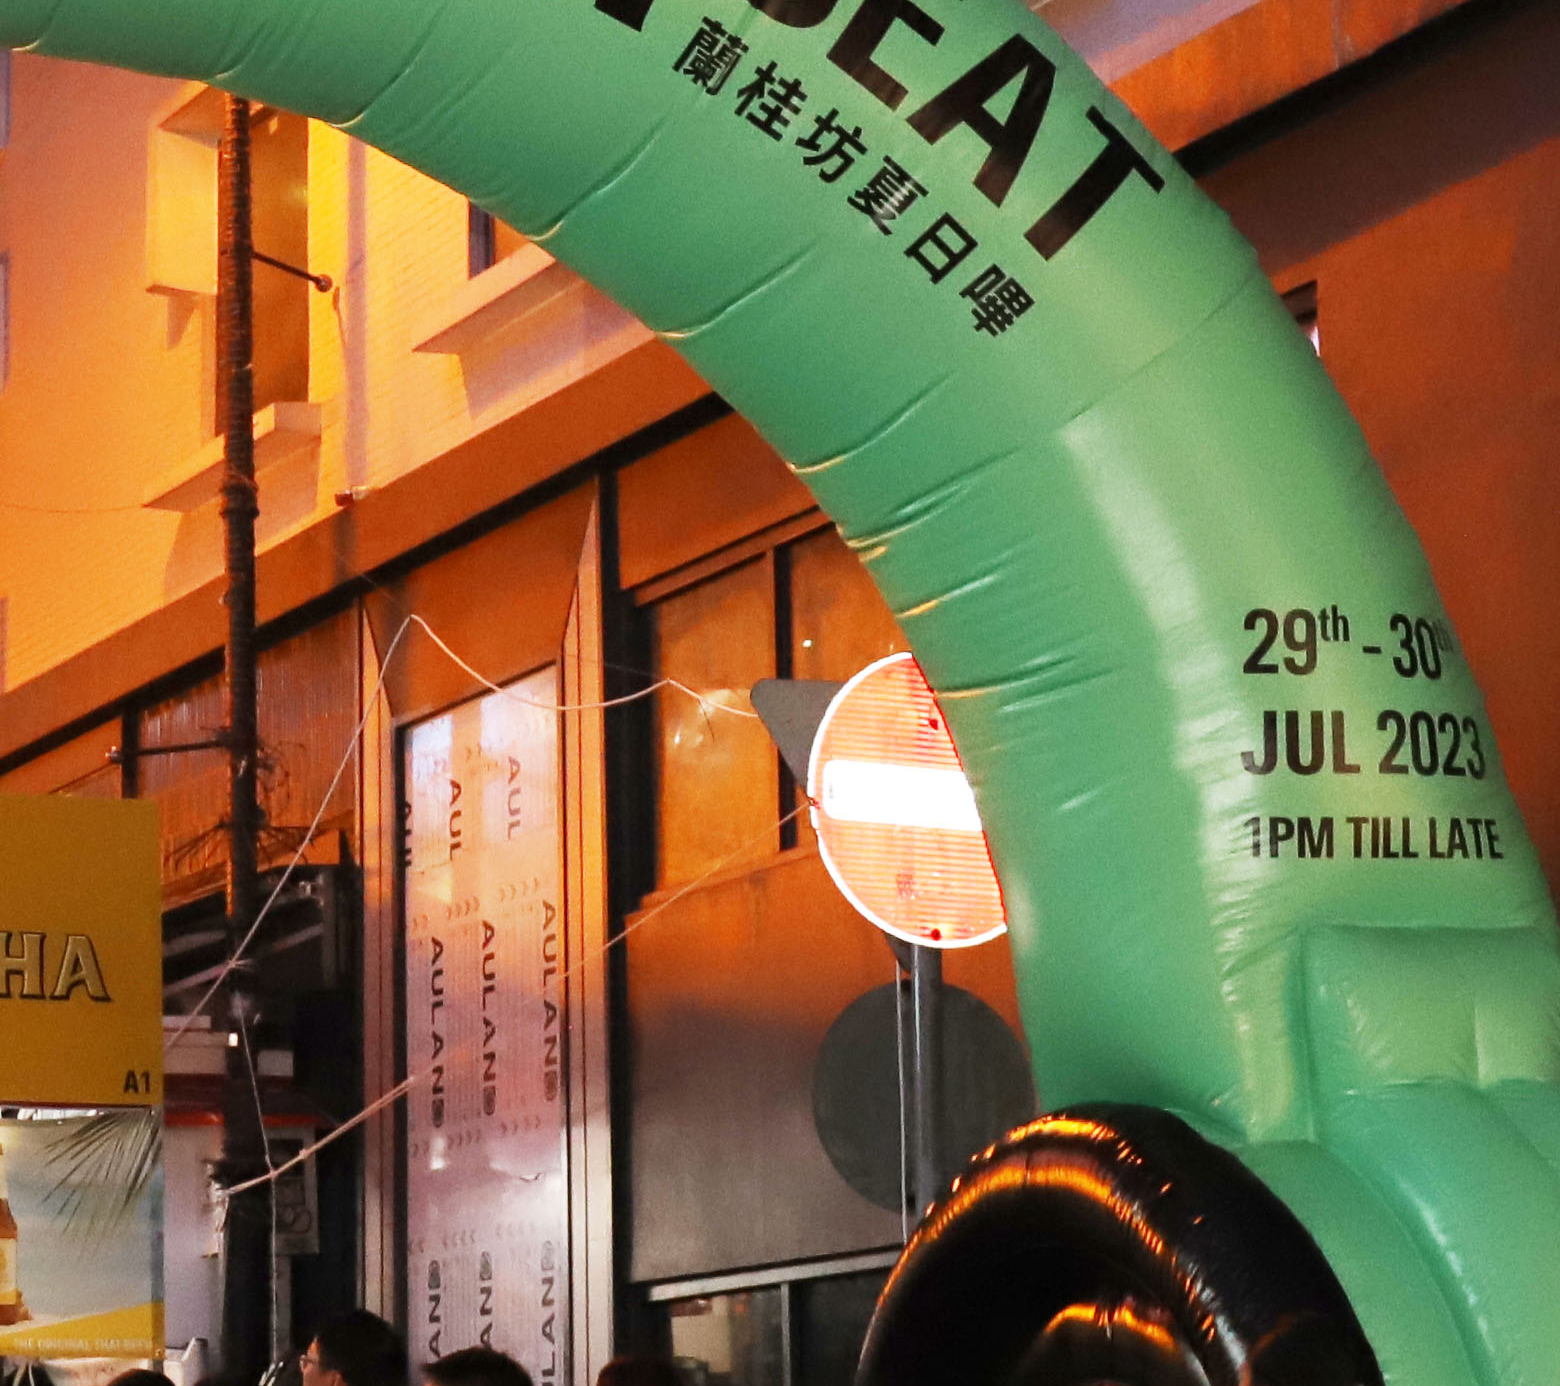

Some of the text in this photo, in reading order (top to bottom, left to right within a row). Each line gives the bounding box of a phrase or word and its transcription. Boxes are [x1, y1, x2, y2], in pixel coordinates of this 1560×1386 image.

[673, 16, 1035, 337] 蘭桂坊夏日嗶
[1242, 603, 1351, 676] 29th
[1240, 709, 1486, 780] JUL 2023
[1242, 816, 1504, 860] 1PM TILL LATE
[430, 935, 444, 1130] AULAND
[480, 918, 497, 1116] AULAND
[123, 1069, 152, 1094] A1
